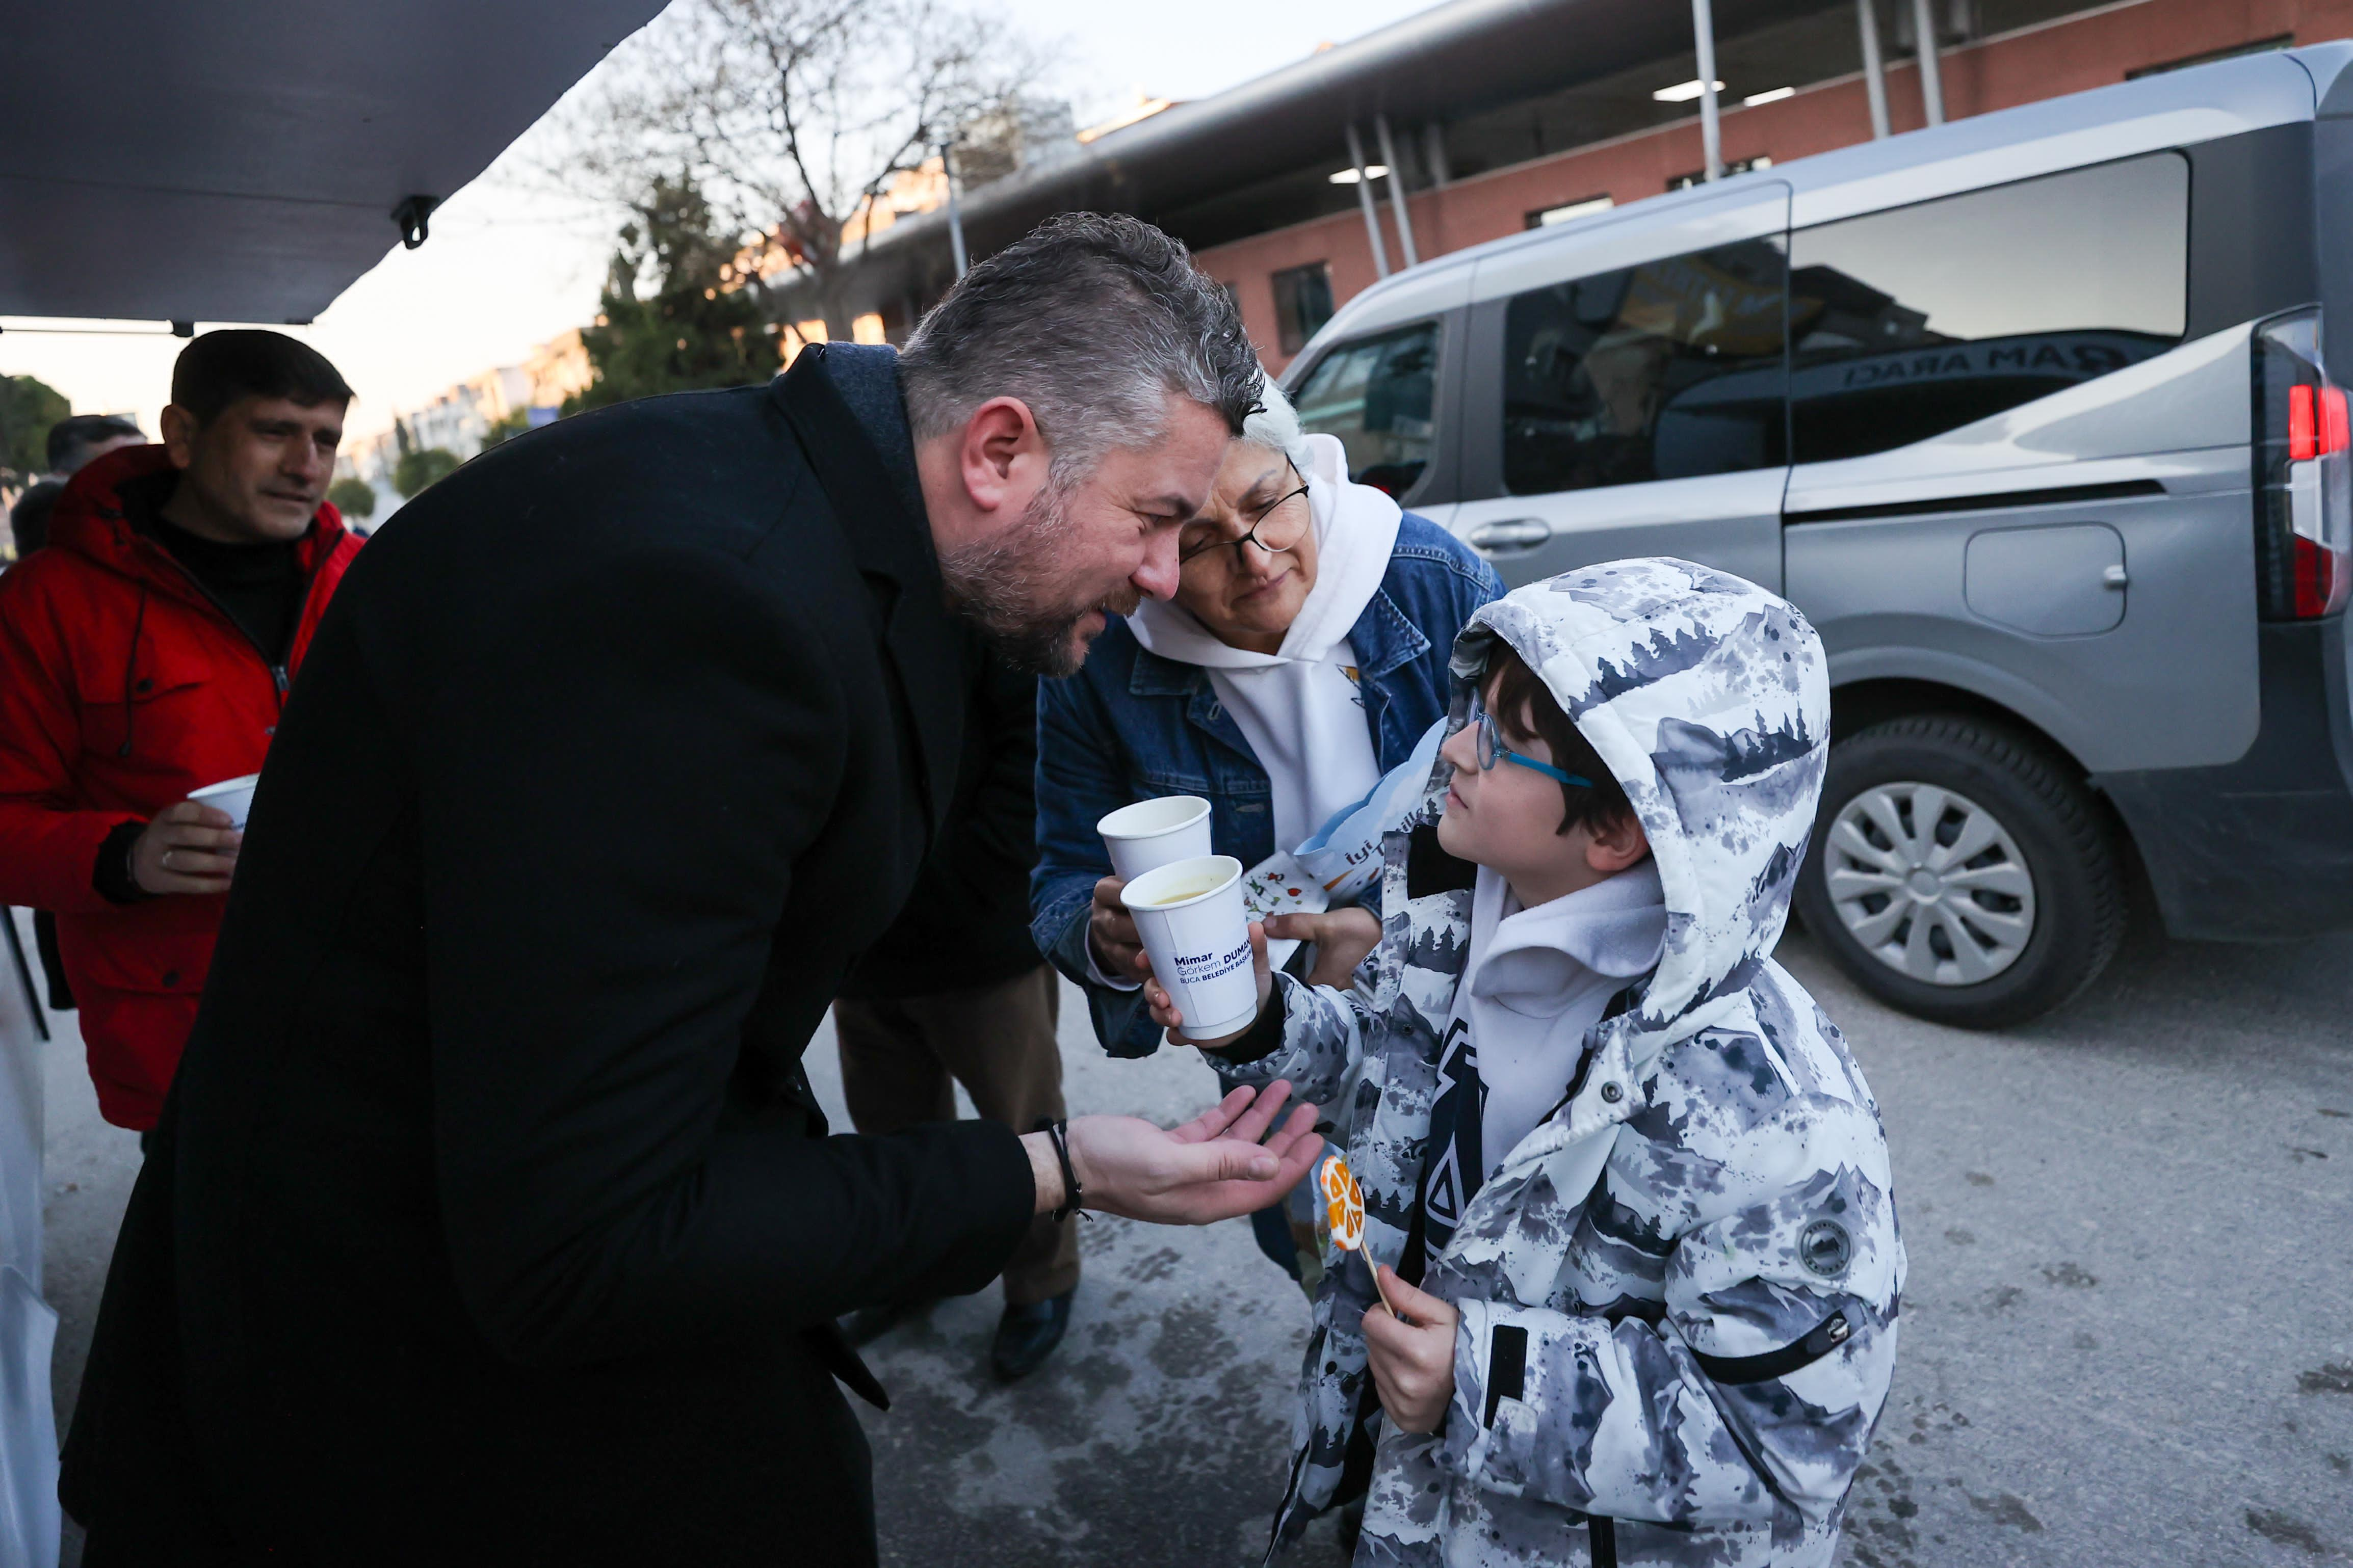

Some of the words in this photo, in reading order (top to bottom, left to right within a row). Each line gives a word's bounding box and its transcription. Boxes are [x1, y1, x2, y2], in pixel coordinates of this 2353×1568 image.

[1174, 952, 1213, 966] Mimar
[1178, 961, 1220, 976] Görkem
[1223, 937, 1250, 964] DUMAN
[1202, 964, 1234, 980] BELEDİYE
